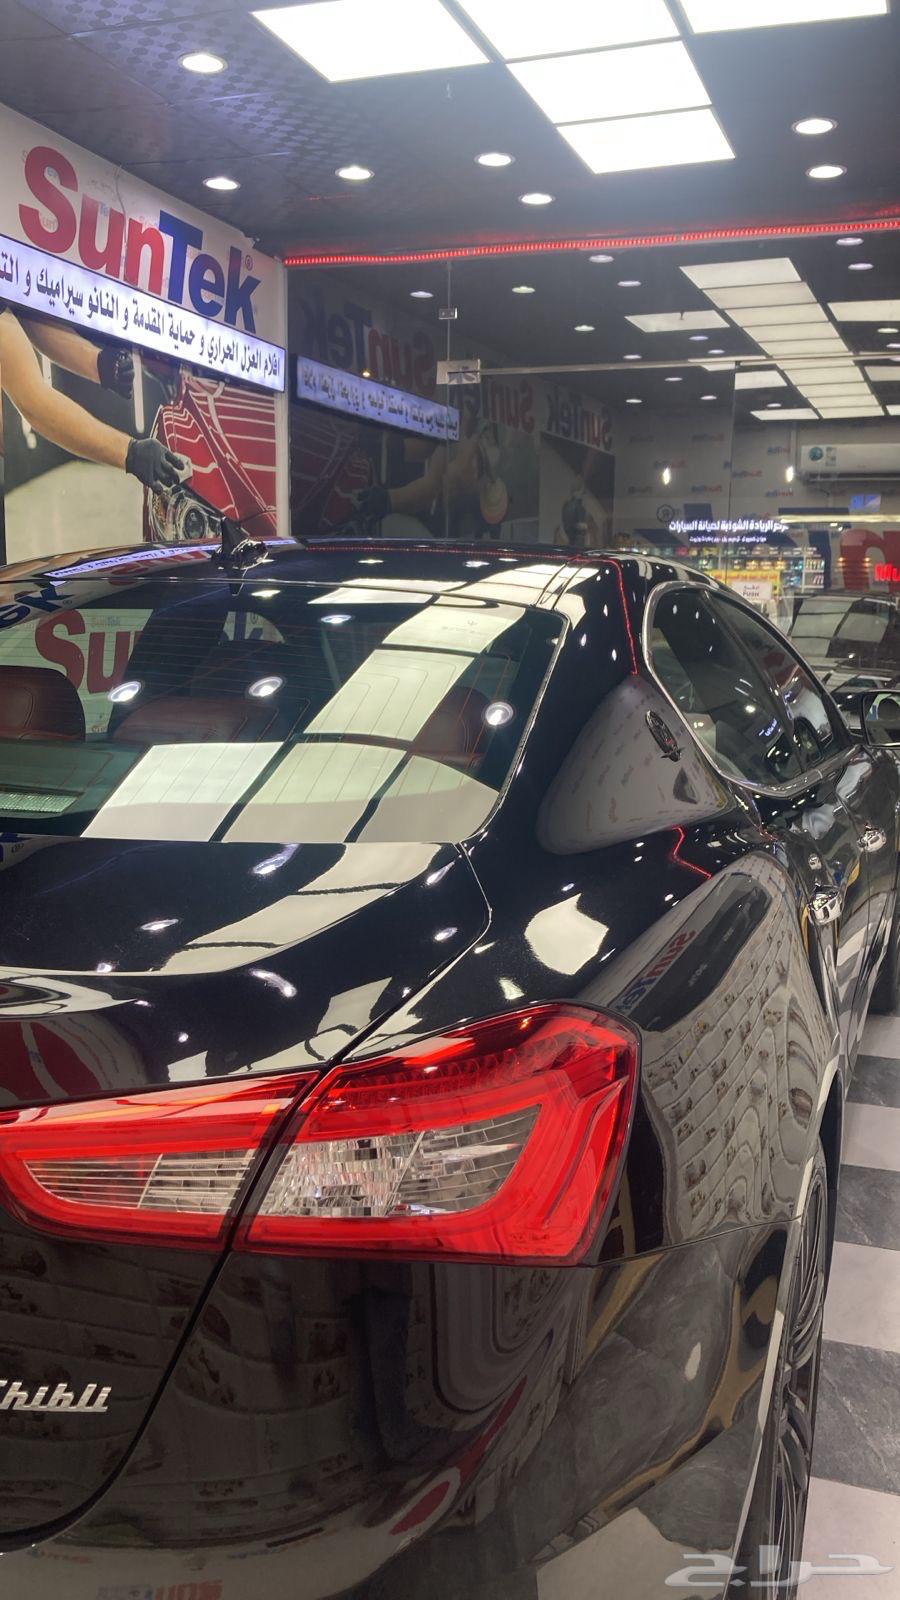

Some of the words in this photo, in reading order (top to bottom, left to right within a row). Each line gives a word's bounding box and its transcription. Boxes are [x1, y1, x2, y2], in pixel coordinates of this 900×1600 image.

[19, 146, 261, 333] SunTek
[23, 269, 32, 296] و
[36, 267, 84, 315] سيراميك
[87, 286, 119, 320] النانو
[133, 298, 164, 336] المقدمة
[122, 307, 129, 330] و
[168, 312, 195, 350] حماية
[199, 335, 205, 356] و
[207, 336, 238, 365] الحراري
[241, 344, 261, 373] العزل
[668, 519, 699, 534] السيارات
